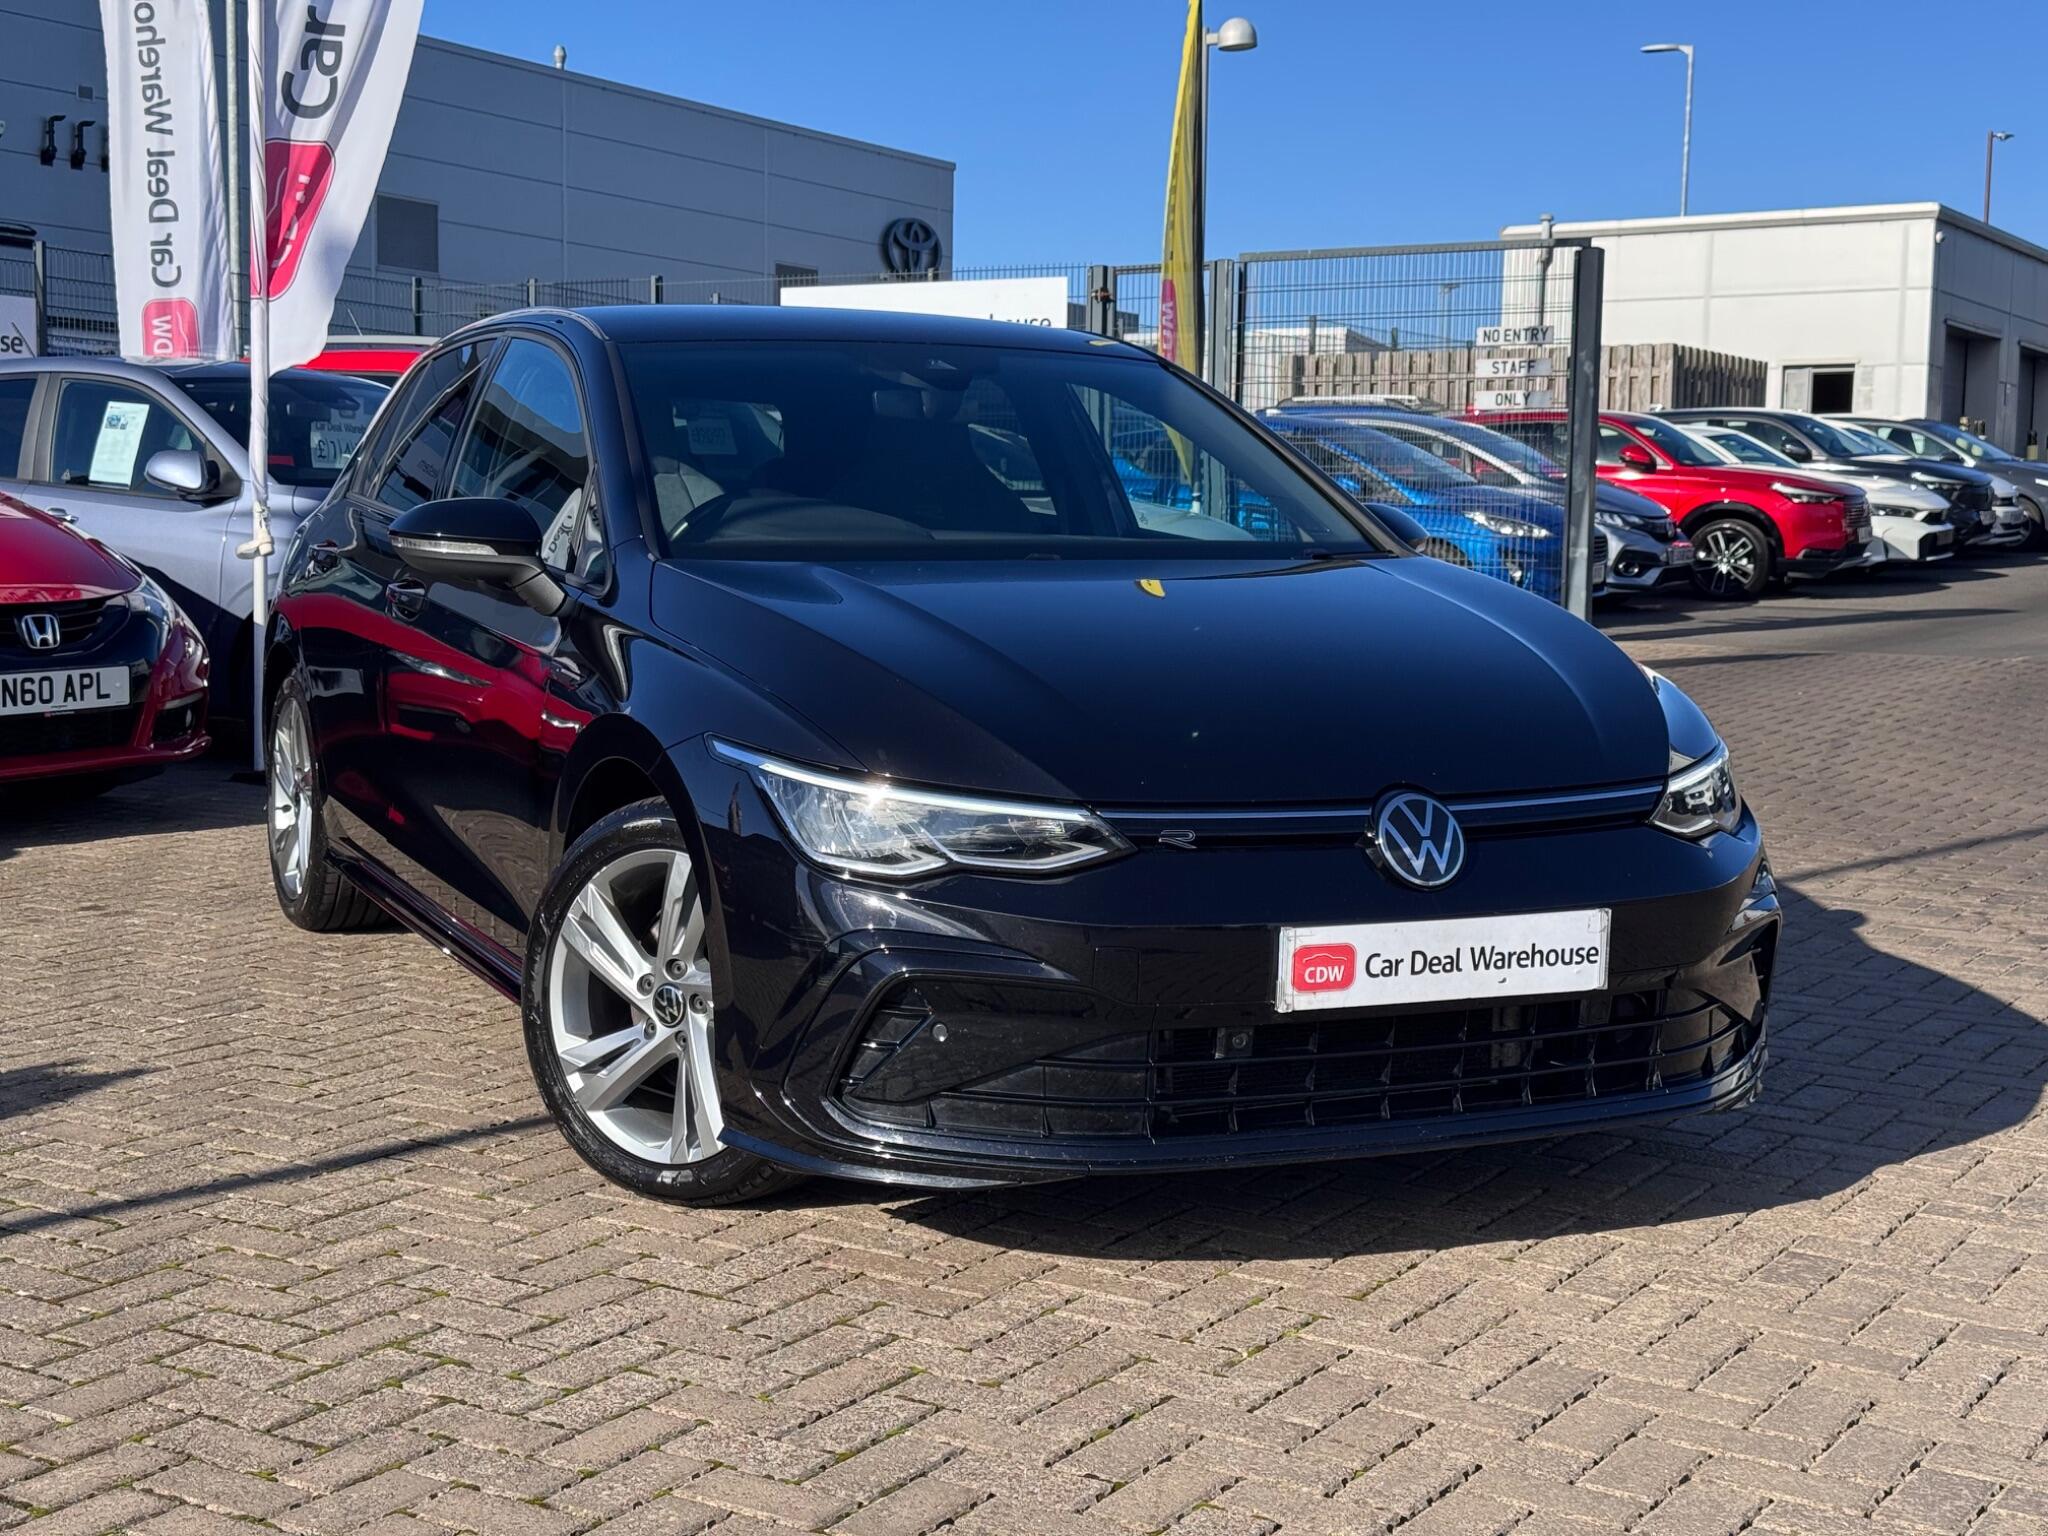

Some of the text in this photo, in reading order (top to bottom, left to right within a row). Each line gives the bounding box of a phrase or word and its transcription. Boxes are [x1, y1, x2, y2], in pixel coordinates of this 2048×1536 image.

[281, 5, 346, 119] Car
[1483, 327, 1549, 343] NO ENTRY
[1492, 360, 1537, 374] STAFF
[1496, 392, 1531, 406] ONLY
[1, 671, 111, 708] N60 APL
[1304, 943, 1599, 984] CDW Car Deal Warehouse
